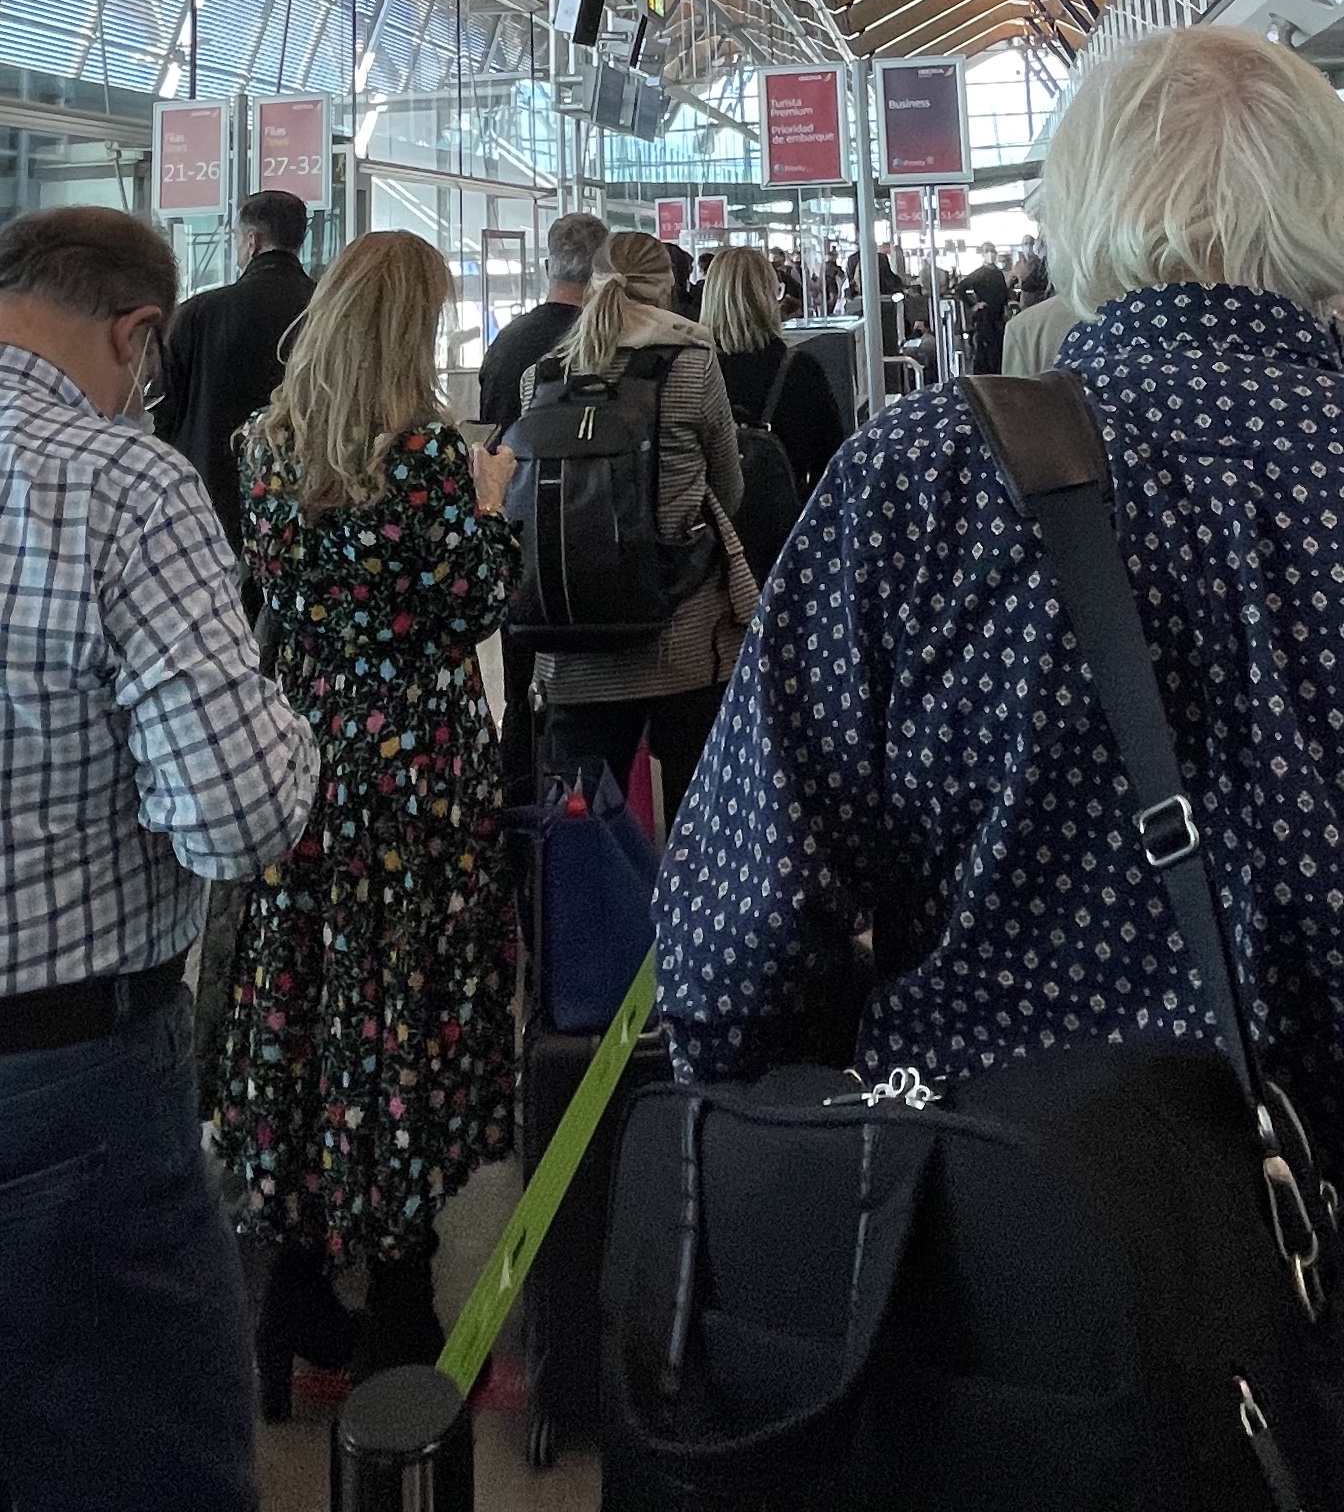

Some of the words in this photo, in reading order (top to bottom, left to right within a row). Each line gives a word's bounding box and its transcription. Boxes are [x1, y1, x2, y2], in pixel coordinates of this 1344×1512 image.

[771, 98, 802, 108] Turista
[888, 99, 931, 109] Business
[771, 107, 814, 117] Premium
[771, 123, 814, 135] Prioridad
[772, 135, 785, 144] de
[786, 132, 835, 144] embarque
[163, 160, 220, 183] 21-26
[263, 155, 323, 177] 27-32
